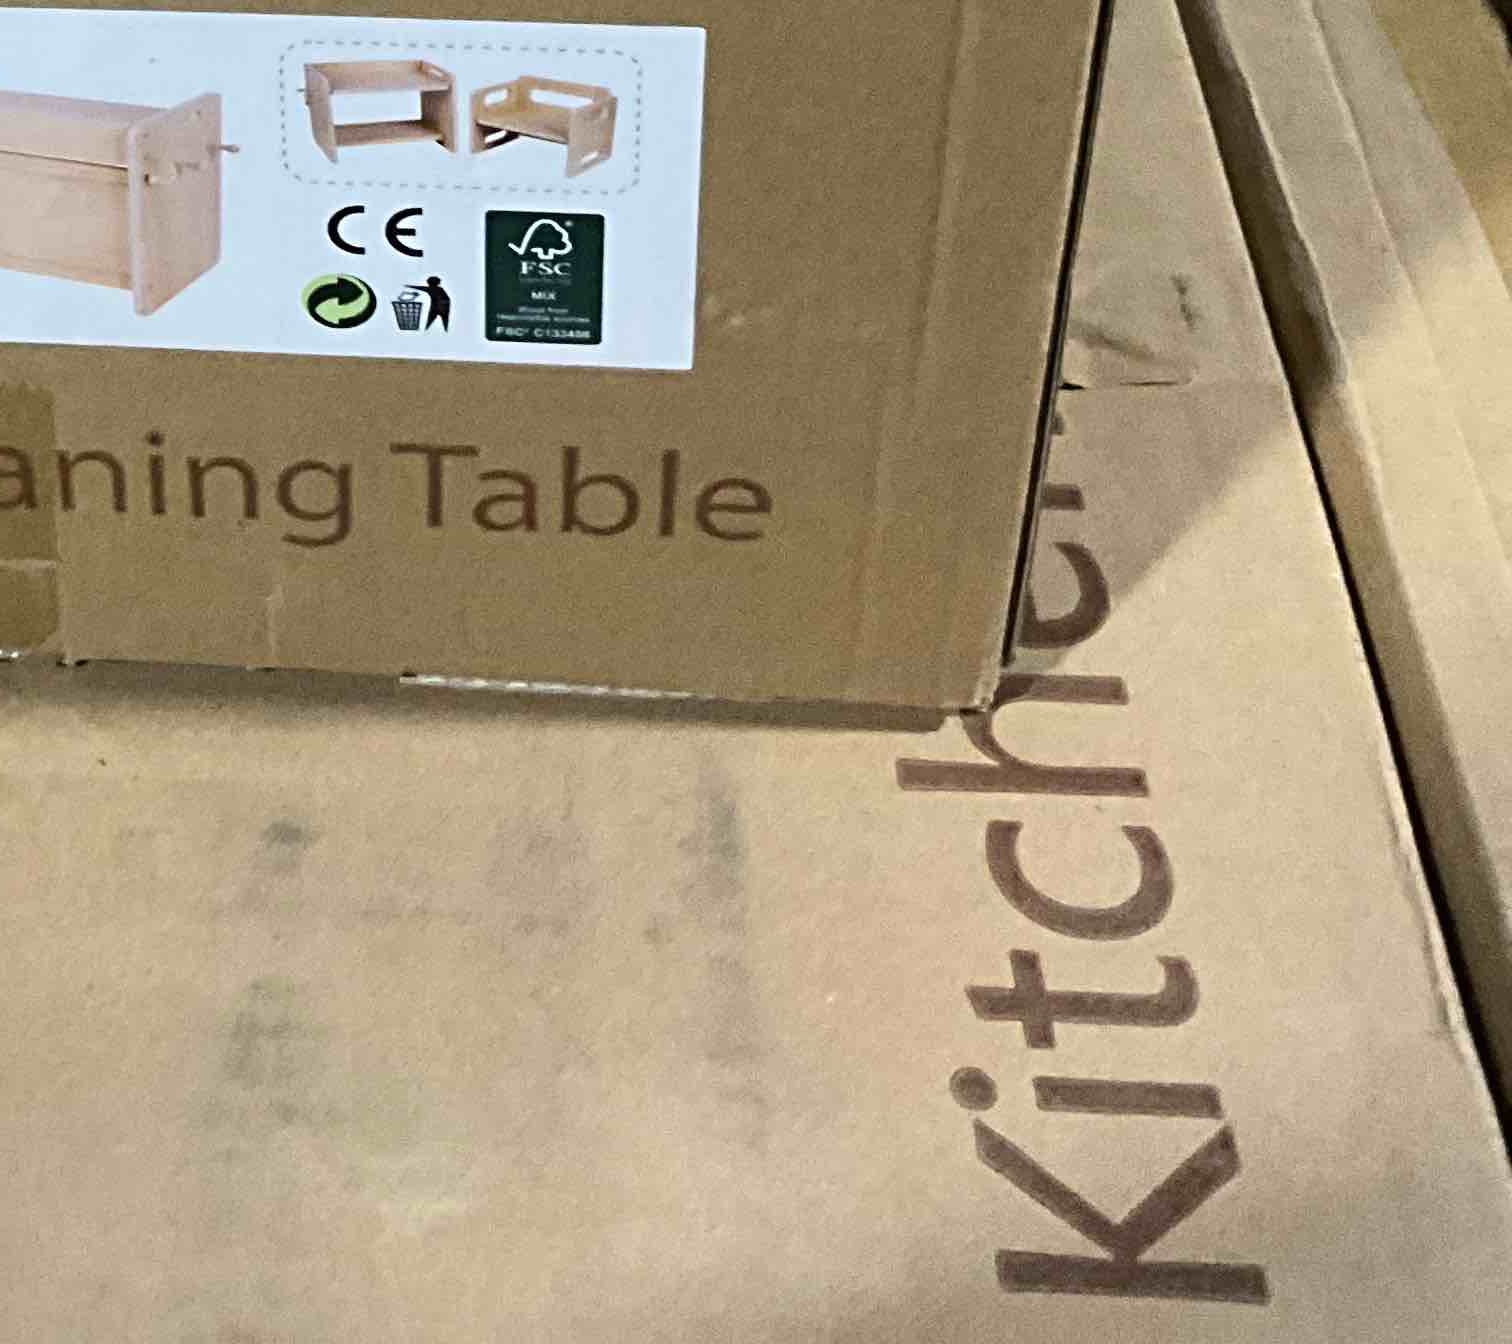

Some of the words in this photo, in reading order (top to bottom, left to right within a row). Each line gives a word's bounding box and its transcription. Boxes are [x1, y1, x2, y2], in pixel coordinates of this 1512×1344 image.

[327, 204, 424, 258] CE
[520, 260, 571, 275] FSC
[390, 441, 775, 541] Table
